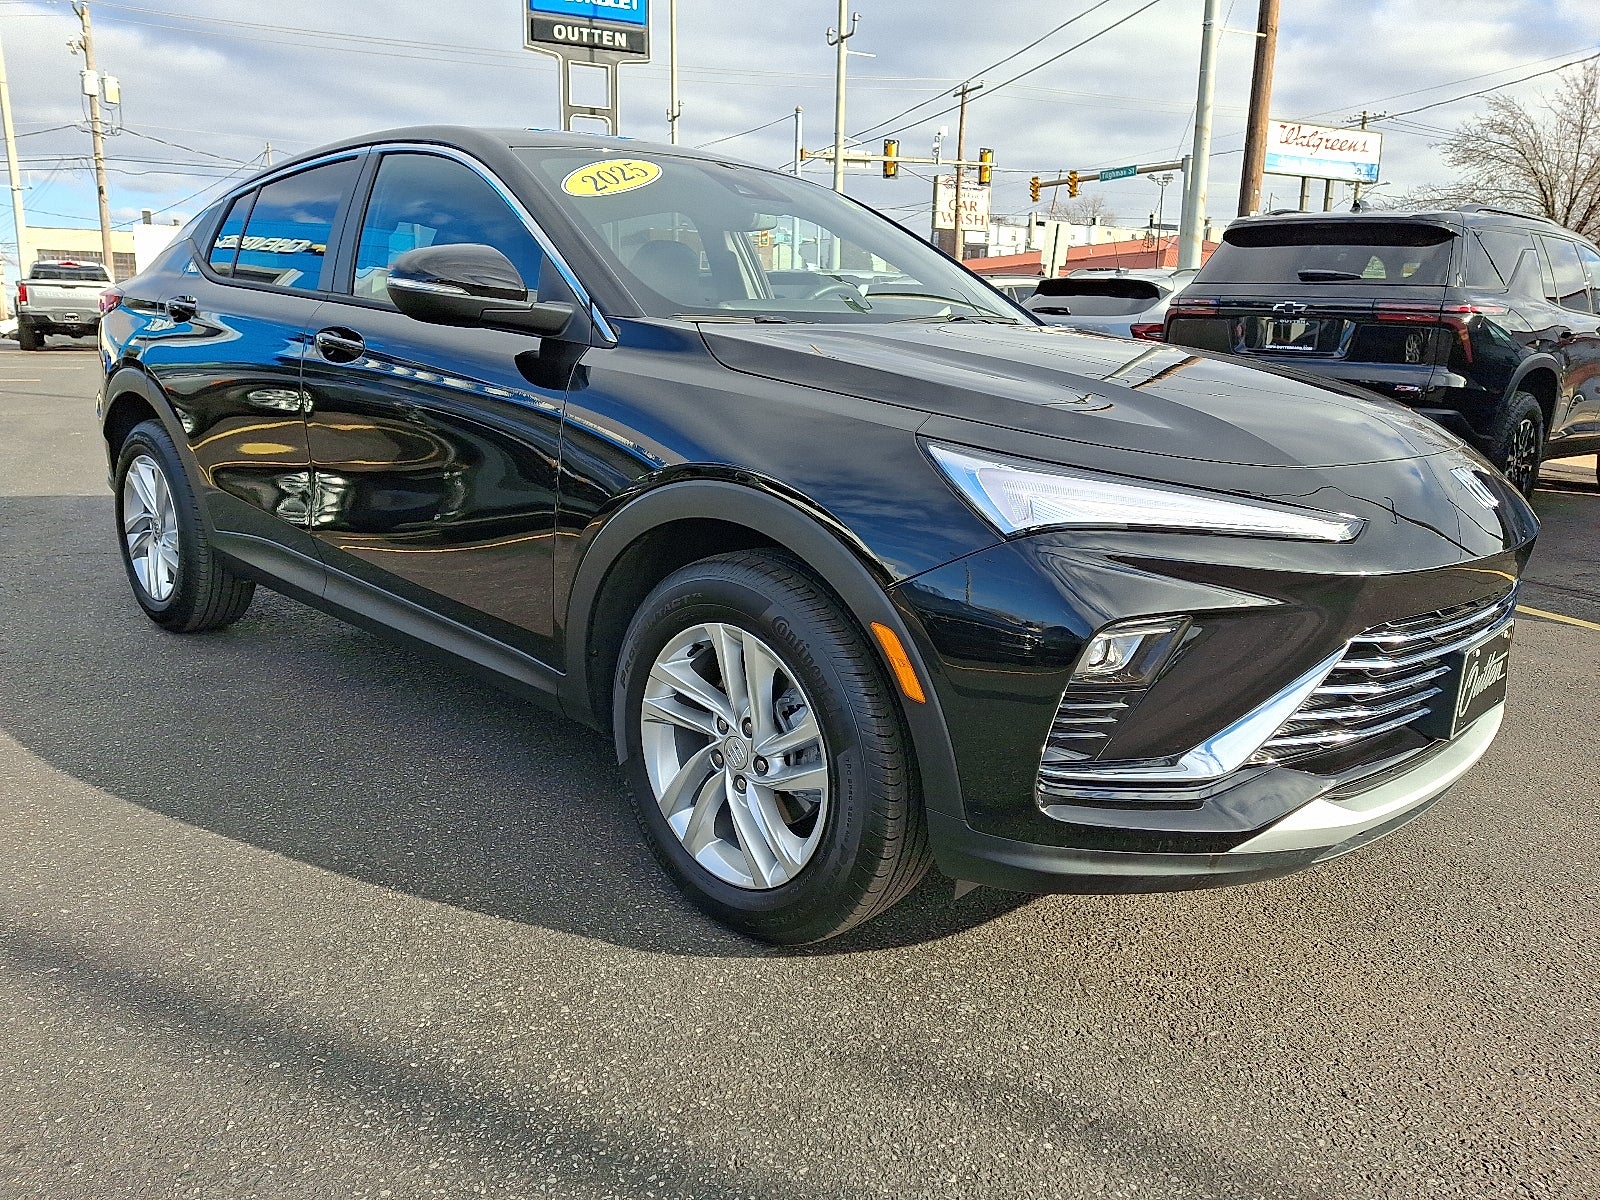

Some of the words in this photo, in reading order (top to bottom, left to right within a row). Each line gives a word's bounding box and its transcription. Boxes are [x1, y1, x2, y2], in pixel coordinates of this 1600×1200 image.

[553, 24, 627, 47] OUTTEN
[1279, 123, 1369, 155] Walgreens
[581, 162, 649, 192] 2025
[948, 199, 977, 212] CAR
[1458, 651, 1509, 718] Outten
